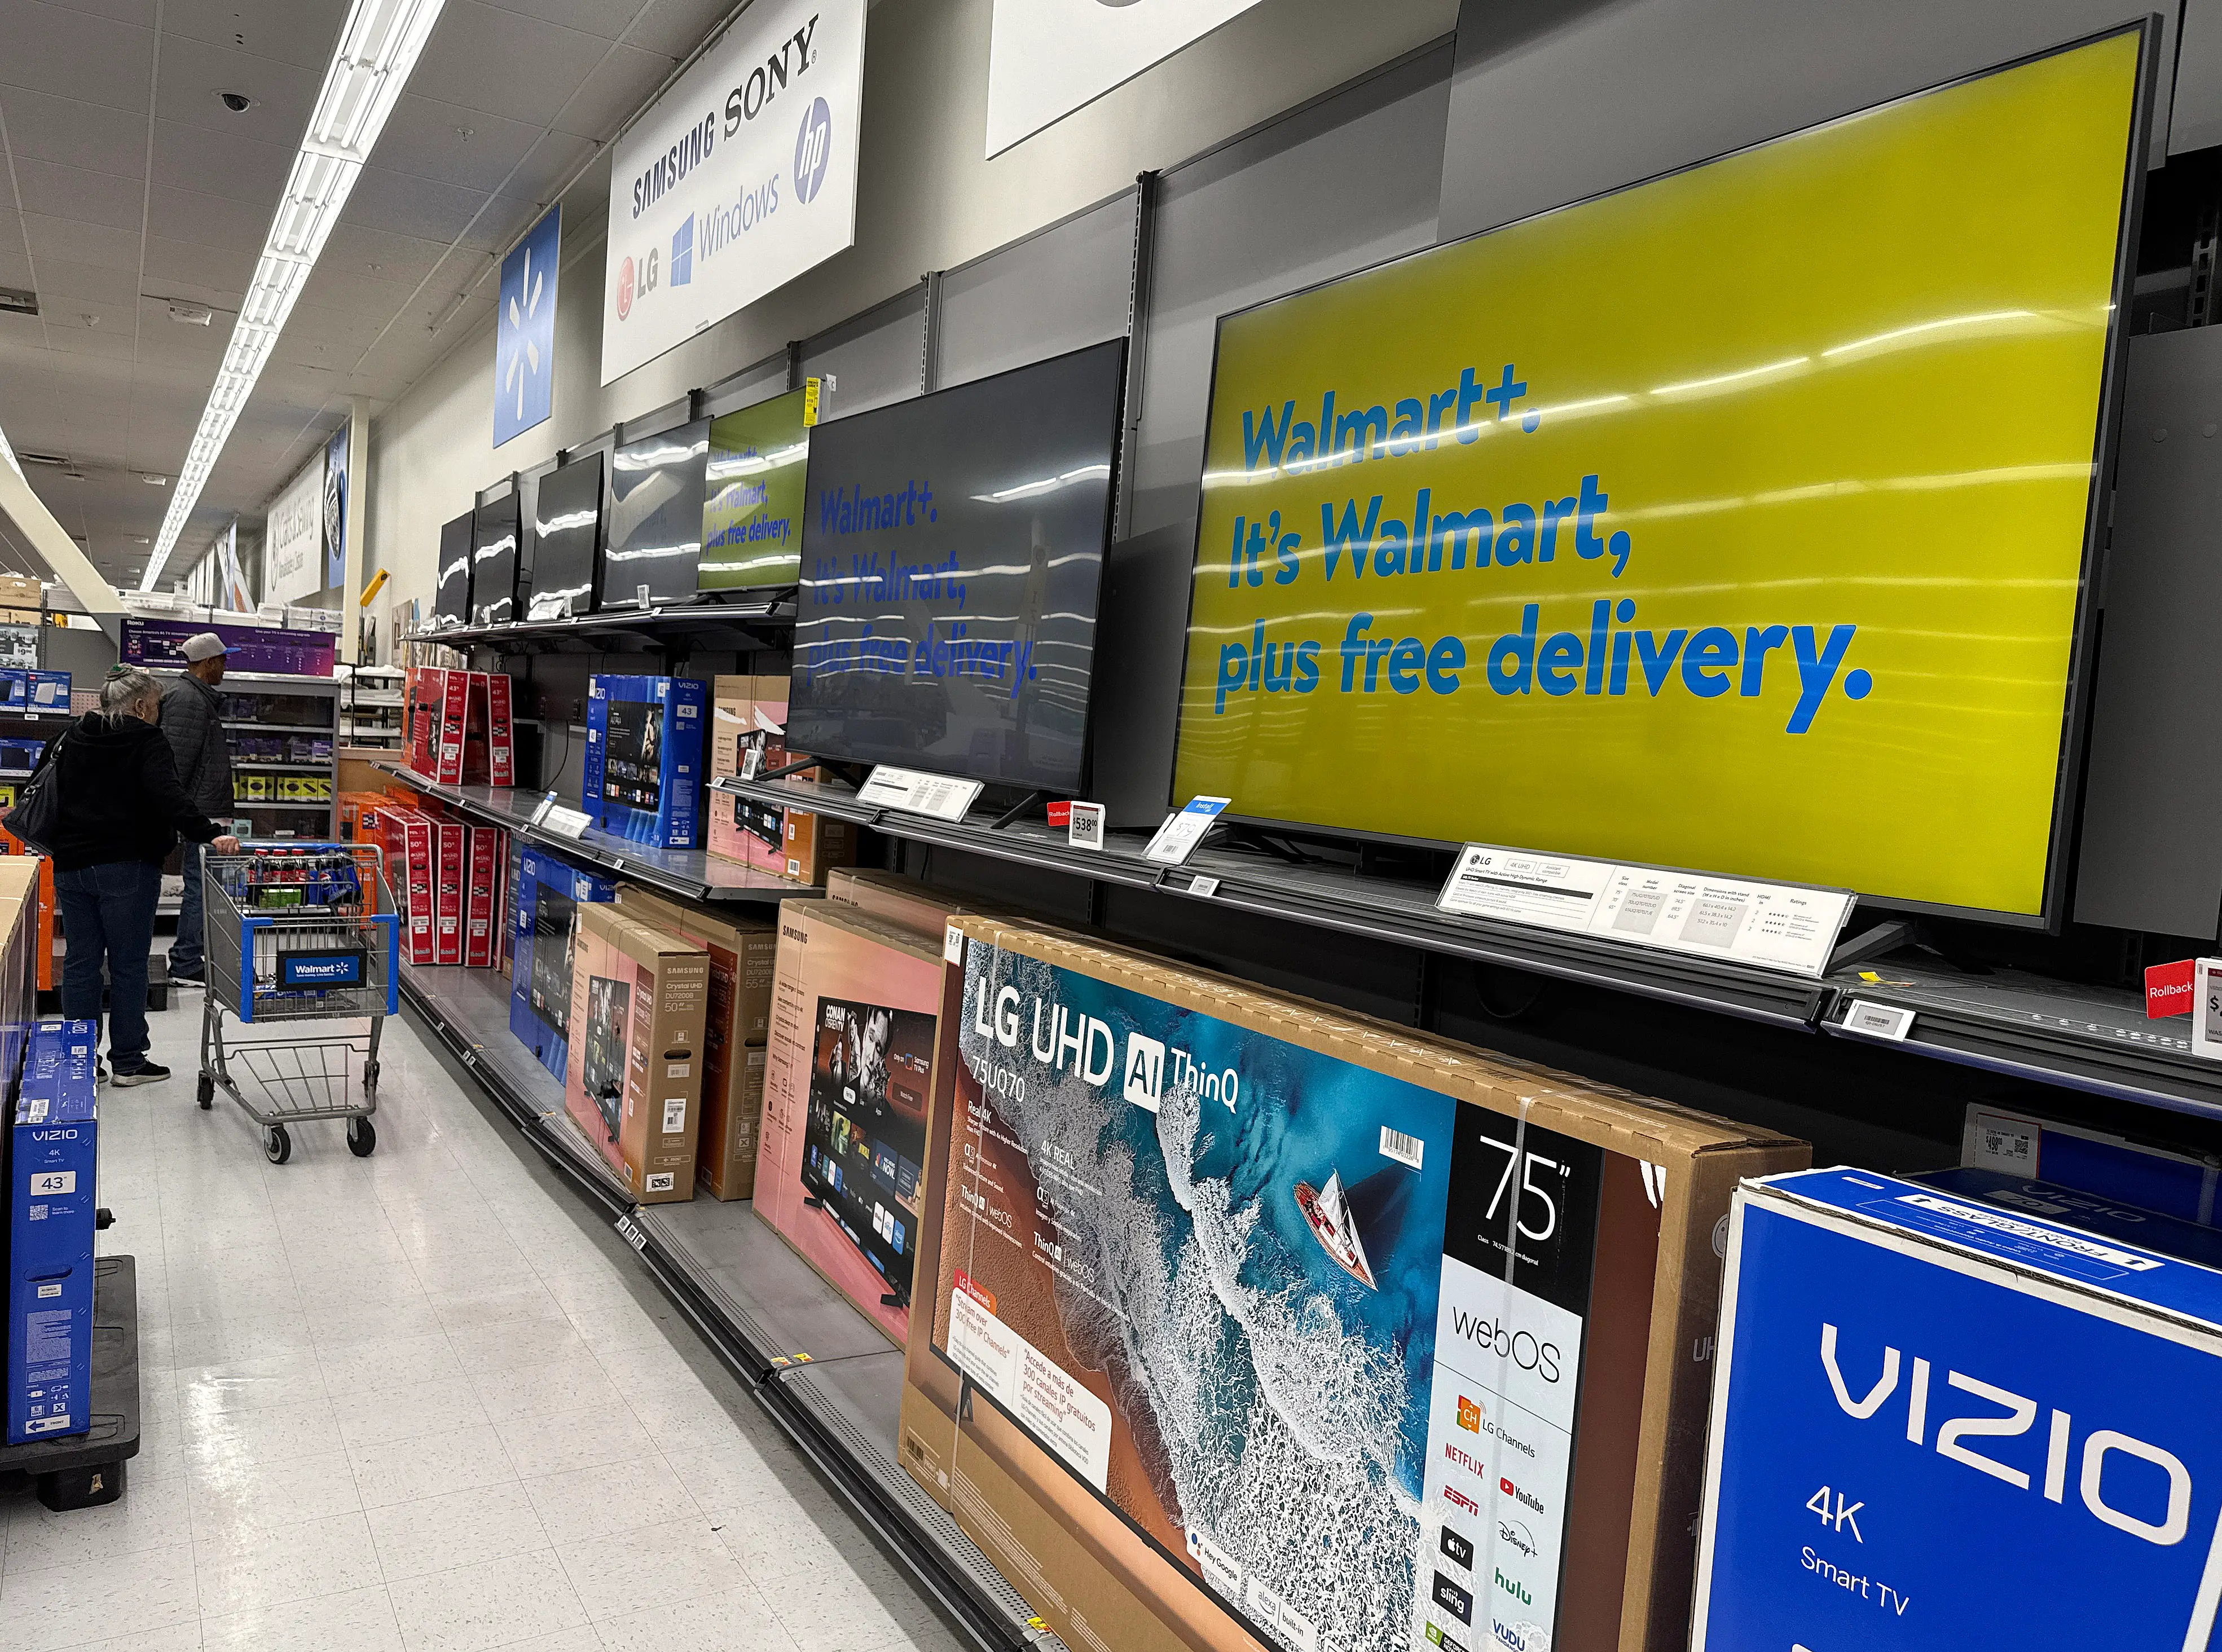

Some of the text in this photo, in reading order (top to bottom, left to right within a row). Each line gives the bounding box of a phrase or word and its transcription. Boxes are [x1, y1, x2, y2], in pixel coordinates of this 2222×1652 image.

[633, 112, 714, 219] SAMSUNG
[797, 98, 829, 204] hp
[699, 173, 778, 262] Windows
[637, 248, 658, 299] LG
[1242, 363, 1541, 483] Walmart+.
[726, 479, 768, 510] Walmart,
[820, 480, 937, 536] Walmart+.
[706, 513, 791, 556] plus free delivery.
[1229, 475, 1631, 589] It's Walmart,
[813, 550, 966, 610] It's Walmart,
[807, 623, 1037, 699] plus free delivery.
[1215, 599, 1872, 734] plus free delivery.
[1177, 823, 1196, 837] $79
[523, 857, 535, 876] VIZIO
[783, 925, 808, 944] SAMSUNG
[295, 964, 335, 973] Walmart
[2150, 981, 2193, 998] Rollback
[665, 1003, 684, 1012] 50"
[826, 1005, 846, 1022] CONAN
[975, 976, 1020, 1047] LG
[1032, 997, 1114, 1086] UHD
[1171, 1047, 1238, 1114] ThinQ
[914, 1056, 929, 1068] Samsung
[972, 1055, 1025, 1103] 75UQ70
[968, 1100, 992, 1124] Real 4K
[33, 1129, 78, 1141] VIZIO
[1001, 1134, 1011, 1144] Higher
[1041, 1140, 1075, 1171] 4K REAL
[961, 1184, 978, 1208] ThinQ
[989, 1206, 1012, 1228] webOS
[1937, 1205, 2110, 1257] FRONT/GLASS
[1032, 1250, 1045, 1263] Control
[1033, 1231, 1054, 1258] ThinQ
[1068, 1257, 1094, 1283] webOS
[1522, 1254, 1539, 1266] diagonal
[959, 1275, 991, 1309] LG Channels
[955, 1309, 966, 1324] 300
[966, 1318, 977, 1334] free
[977, 1325, 983, 1337] IP
[976, 1313, 988, 1327] over
[1453, 1306, 1561, 1384] webOS
[1692, 1337, 1717, 1363] UH
[1023, 1381, 1033, 1394] por
[1023, 1364, 1095, 1432] 300 canales IP gratuitos
[1048, 1370, 1051, 1379] a
[1053, 1374, 1064, 1391] más
[1066, 1382, 1074, 1398] de
[1463, 1408, 1535, 1458] CH LG Channels
[1820, 1322, 2193, 1547] VIZIO
[1445, 1442, 1485, 1480] NETFLIX
[1444, 1484, 1479, 1517] ESPN
[1515, 1485, 1545, 1515] YouTube
[1806, 1486, 1865, 1544] 4K
[1204, 1548, 1238, 1581] Hey Google
[1495, 1567, 1532, 1606] hulu
[1801, 1547, 1910, 1617] Smart TV
[1258, 1591, 1277, 1611] alexa
[1441, 1587, 1465, 1616] sling
[1282, 1612, 1304, 1637] built-in
[1493, 1618, 1525, 1651] VUDU
